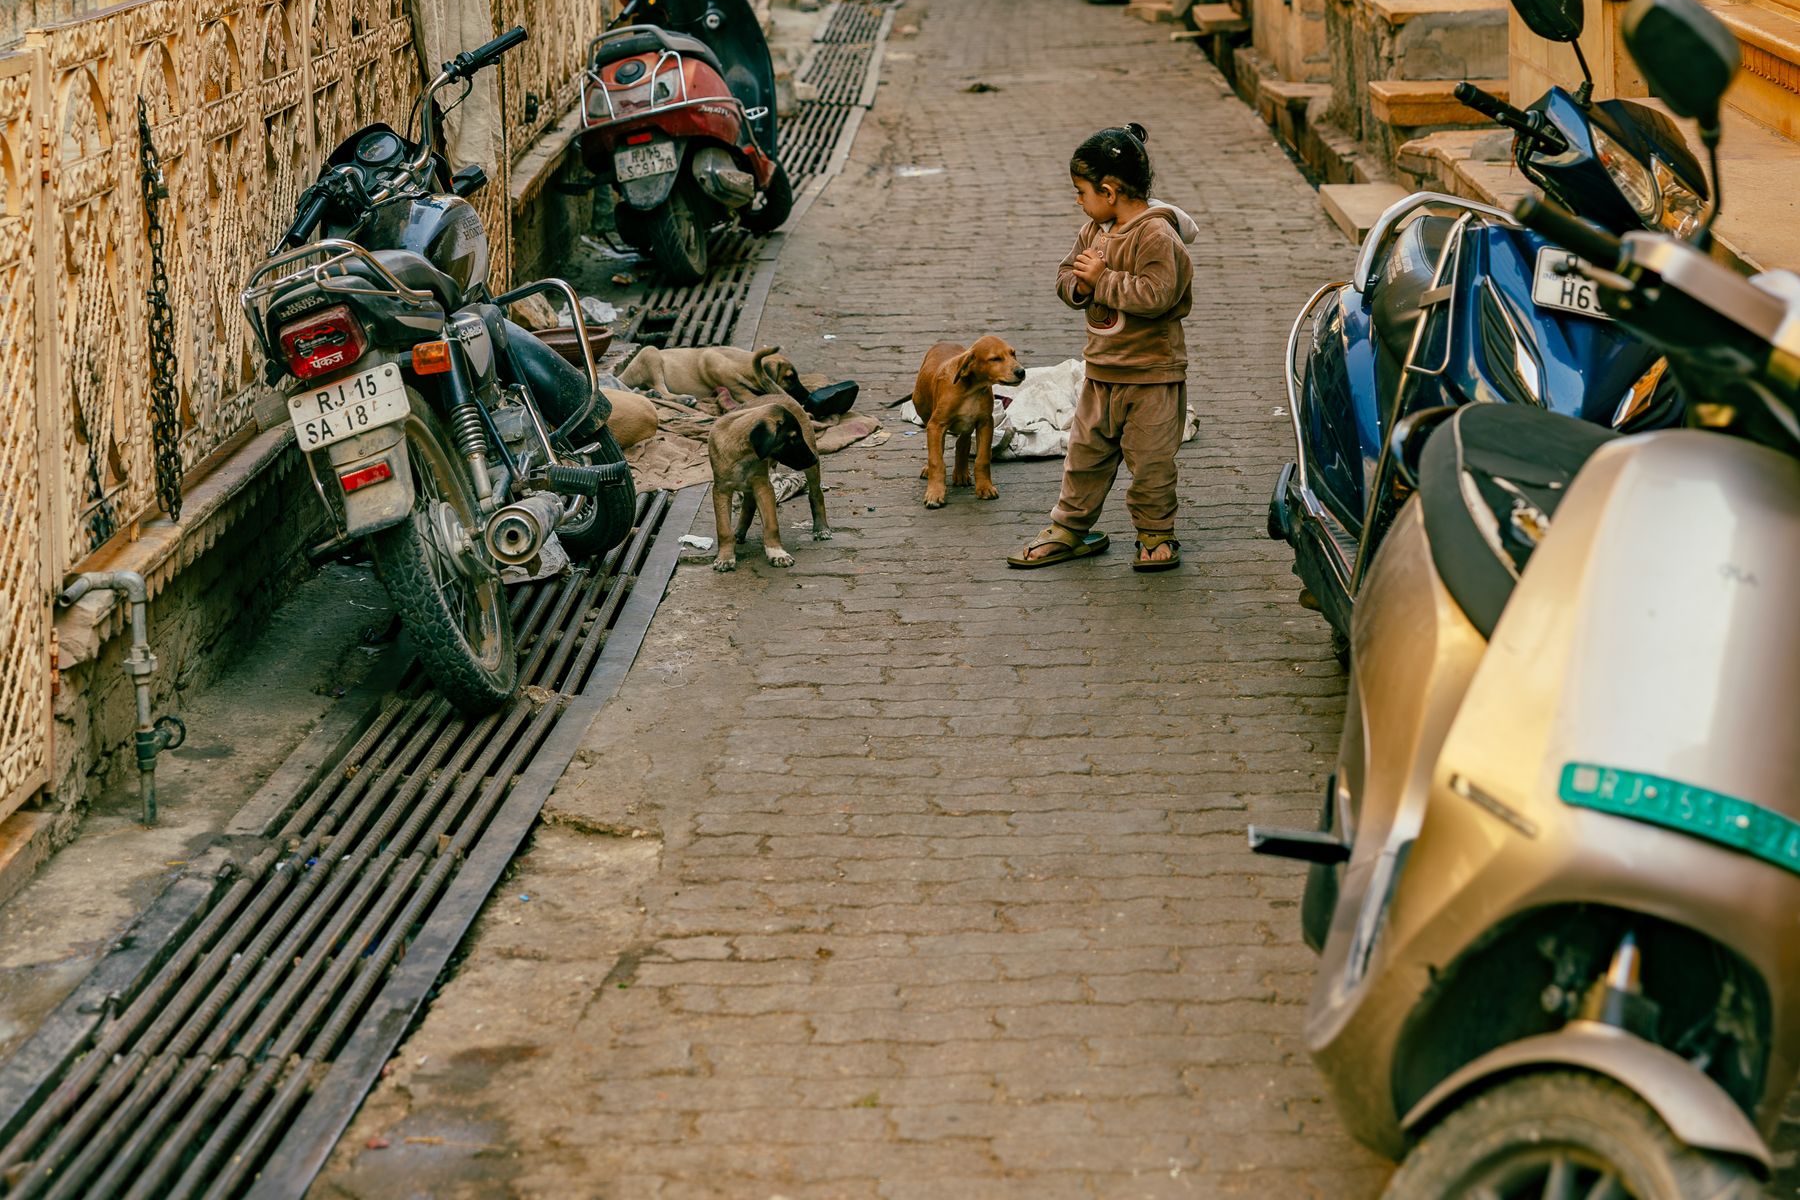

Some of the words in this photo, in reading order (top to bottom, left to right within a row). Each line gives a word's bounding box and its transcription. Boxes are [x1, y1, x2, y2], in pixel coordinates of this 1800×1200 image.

[280, 296, 326, 318] HONDA
[286, 295, 316, 310] HERO
[1560, 280, 1602, 312] H6
[309, 350, 344, 370] पंकज
[316, 385, 346, 414] RJ
[353, 374, 378, 399] 15
[305, 420, 335, 445] SA
[344, 405, 369, 430] 18
